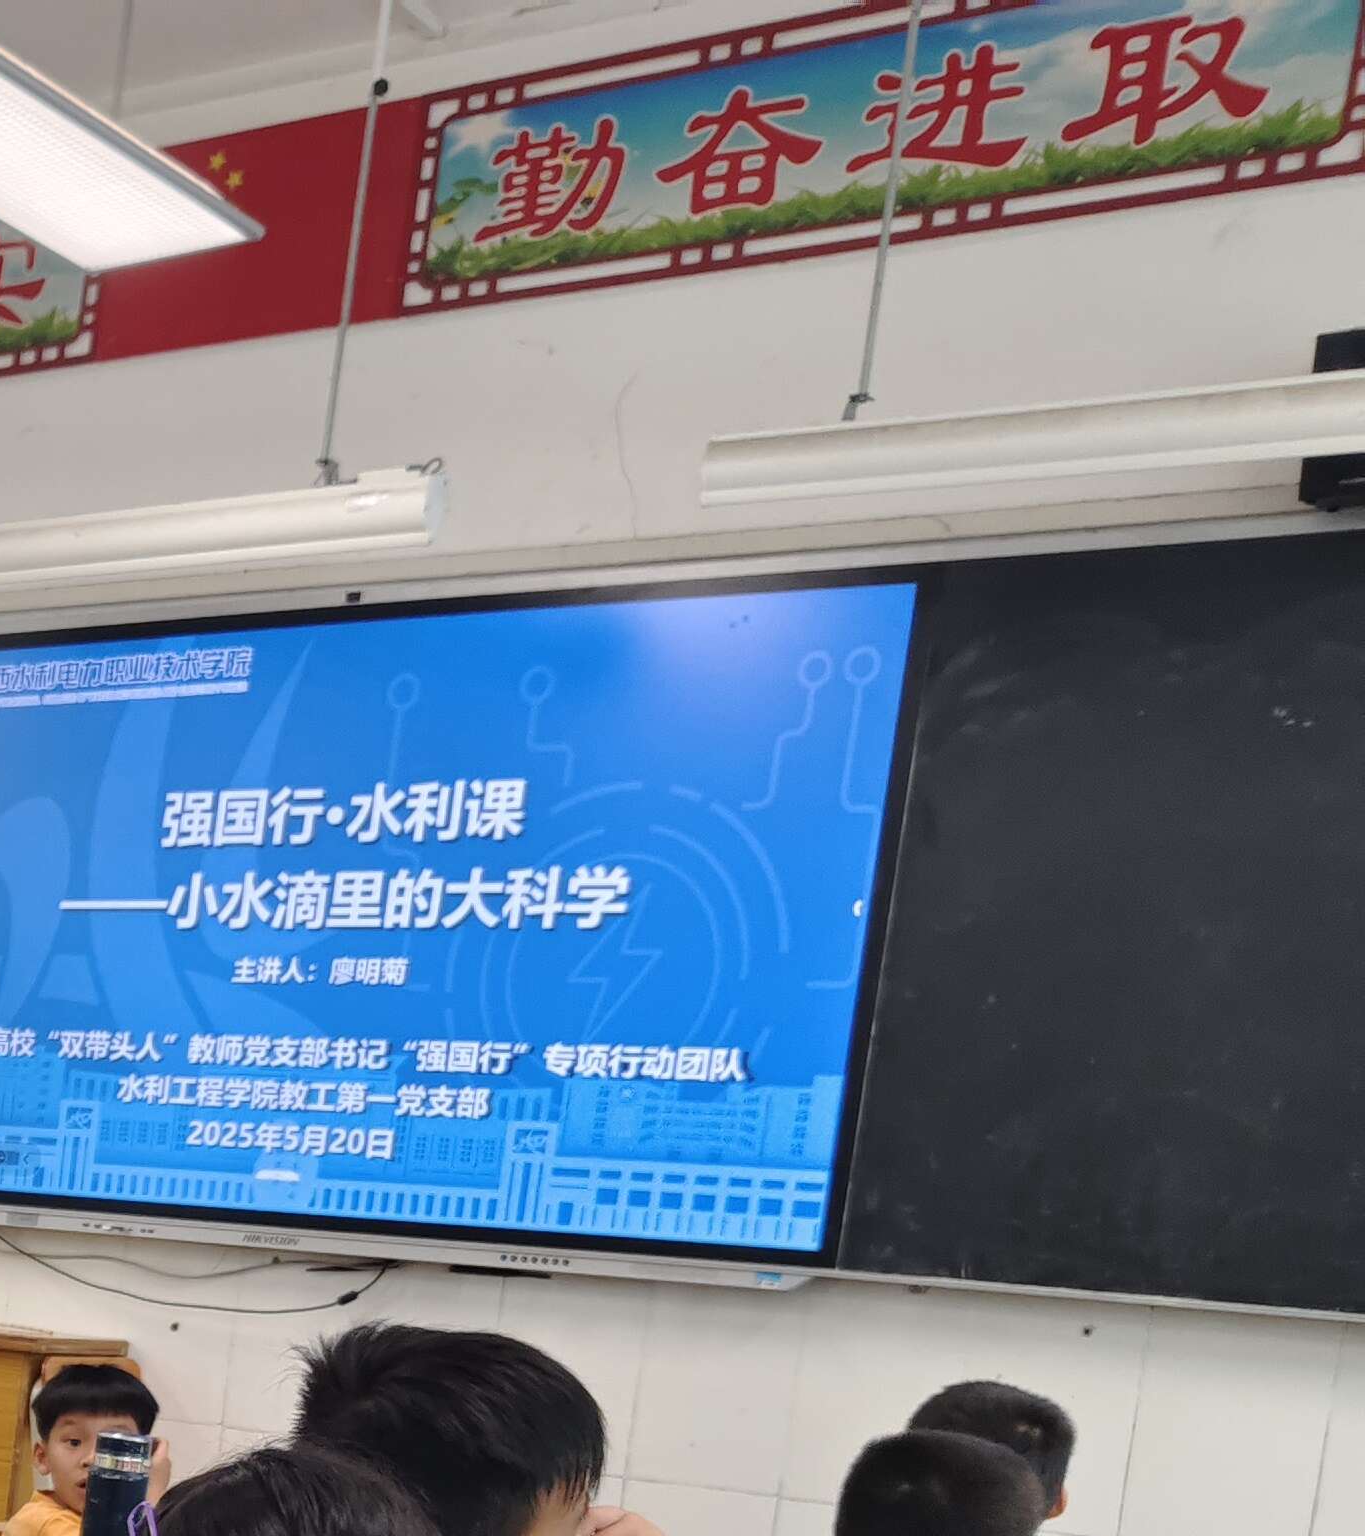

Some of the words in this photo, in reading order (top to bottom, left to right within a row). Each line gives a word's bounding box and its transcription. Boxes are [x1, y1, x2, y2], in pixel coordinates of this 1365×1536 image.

[473, 15, 1269, 245] 勤奋进取
[117, 1073, 492, 1121] 水利工程学院教工第一党支部
[186, 1120, 395, 1161] 2025年5月20日
